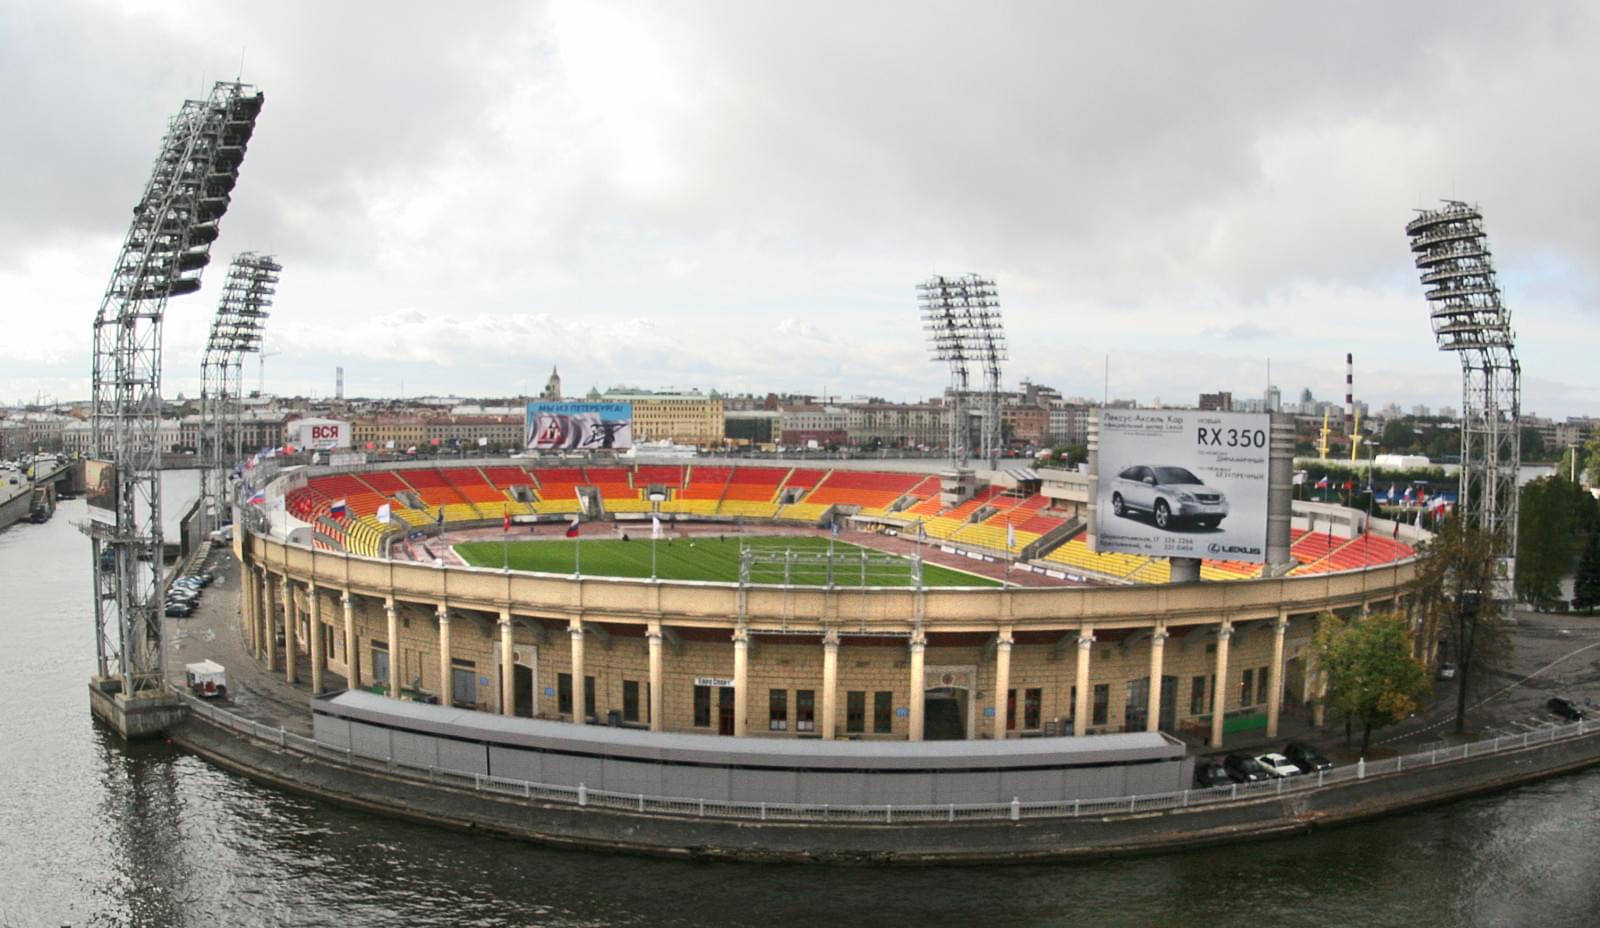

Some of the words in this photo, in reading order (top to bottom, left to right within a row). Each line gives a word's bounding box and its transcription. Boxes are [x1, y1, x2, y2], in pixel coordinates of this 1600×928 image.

[538, 404, 554, 412] МЫ
[312, 425, 339, 438] ВСЯ
[1197, 426, 1223, 446] RX
[1226, 428, 1266, 448] 350
[1221, 545, 1262, 556] LEXUS
